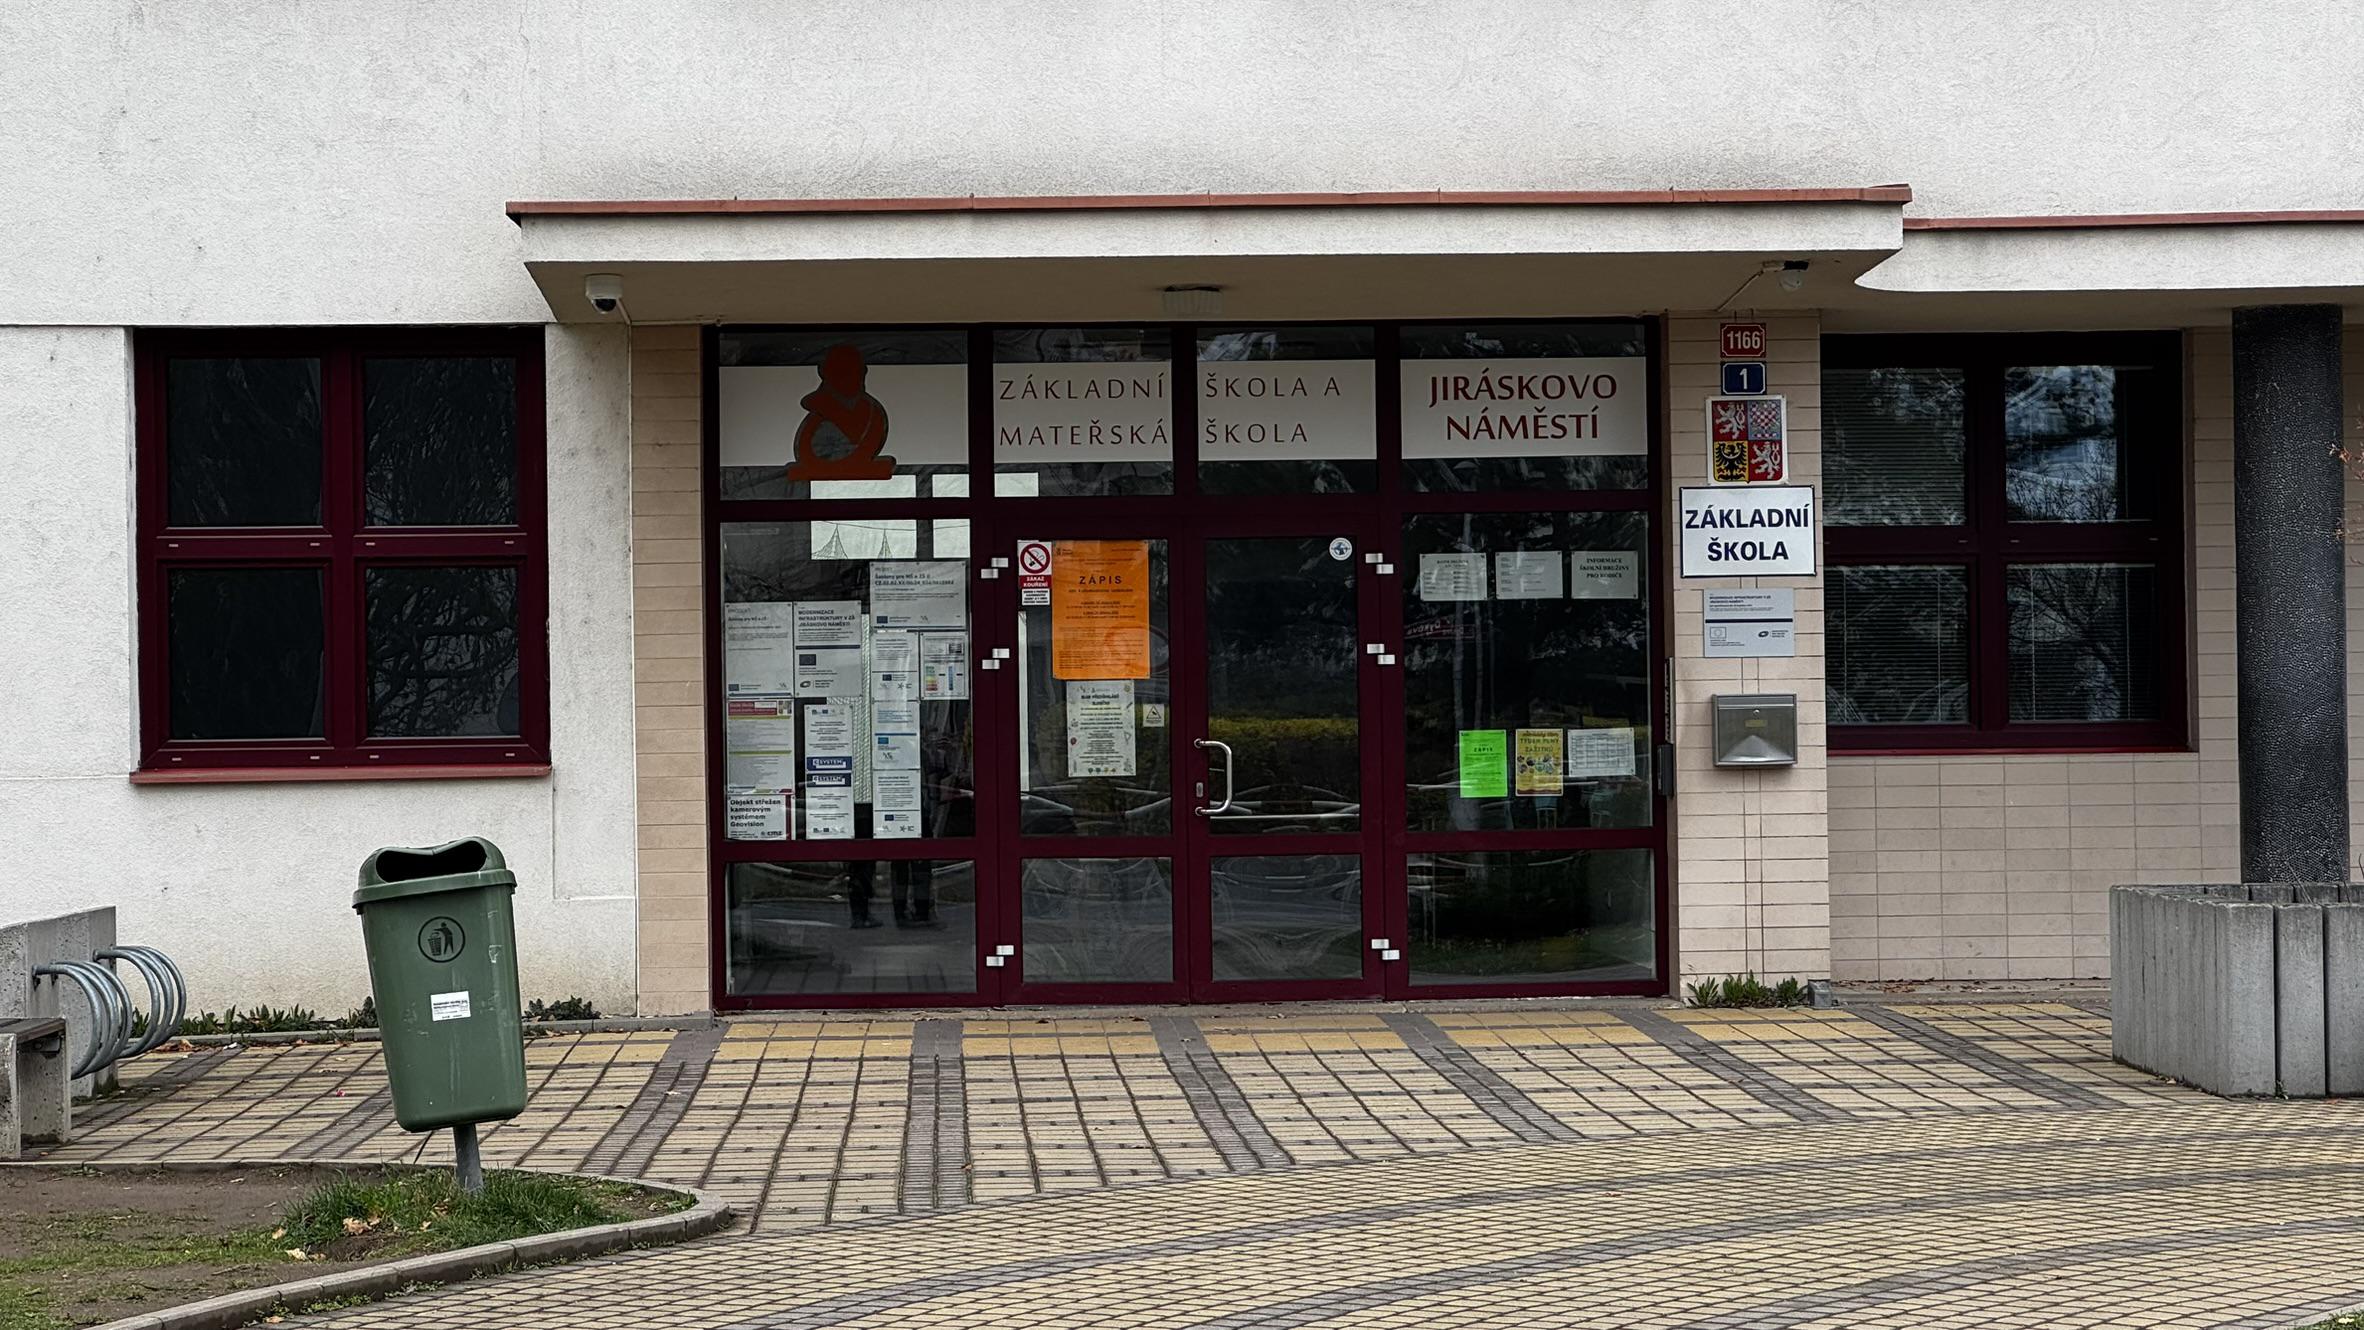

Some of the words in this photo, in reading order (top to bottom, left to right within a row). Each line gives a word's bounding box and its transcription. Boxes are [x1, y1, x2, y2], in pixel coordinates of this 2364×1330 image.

[1727, 331, 1761, 350] 1166
[1000, 374, 1164, 400] ZÁKLADNÍ
[1206, 372, 1308, 398] ŠKOLA
[1324, 377, 1341, 396] A
[1430, 368, 1617, 408] JIRÁSKOVO
[1739, 368, 1748, 390] 1
[1000, 418, 1168, 446] MATEŘSKÁ
[1206, 418, 1309, 444] ŠKOLA
[1447, 406, 1599, 440] NÁMĚSTÍ
[1685, 505, 1809, 530] ZÁKLADNÍ
[1707, 537, 1789, 561] ŠKOLA
[1079, 575, 1122, 585] ZÁPIS
